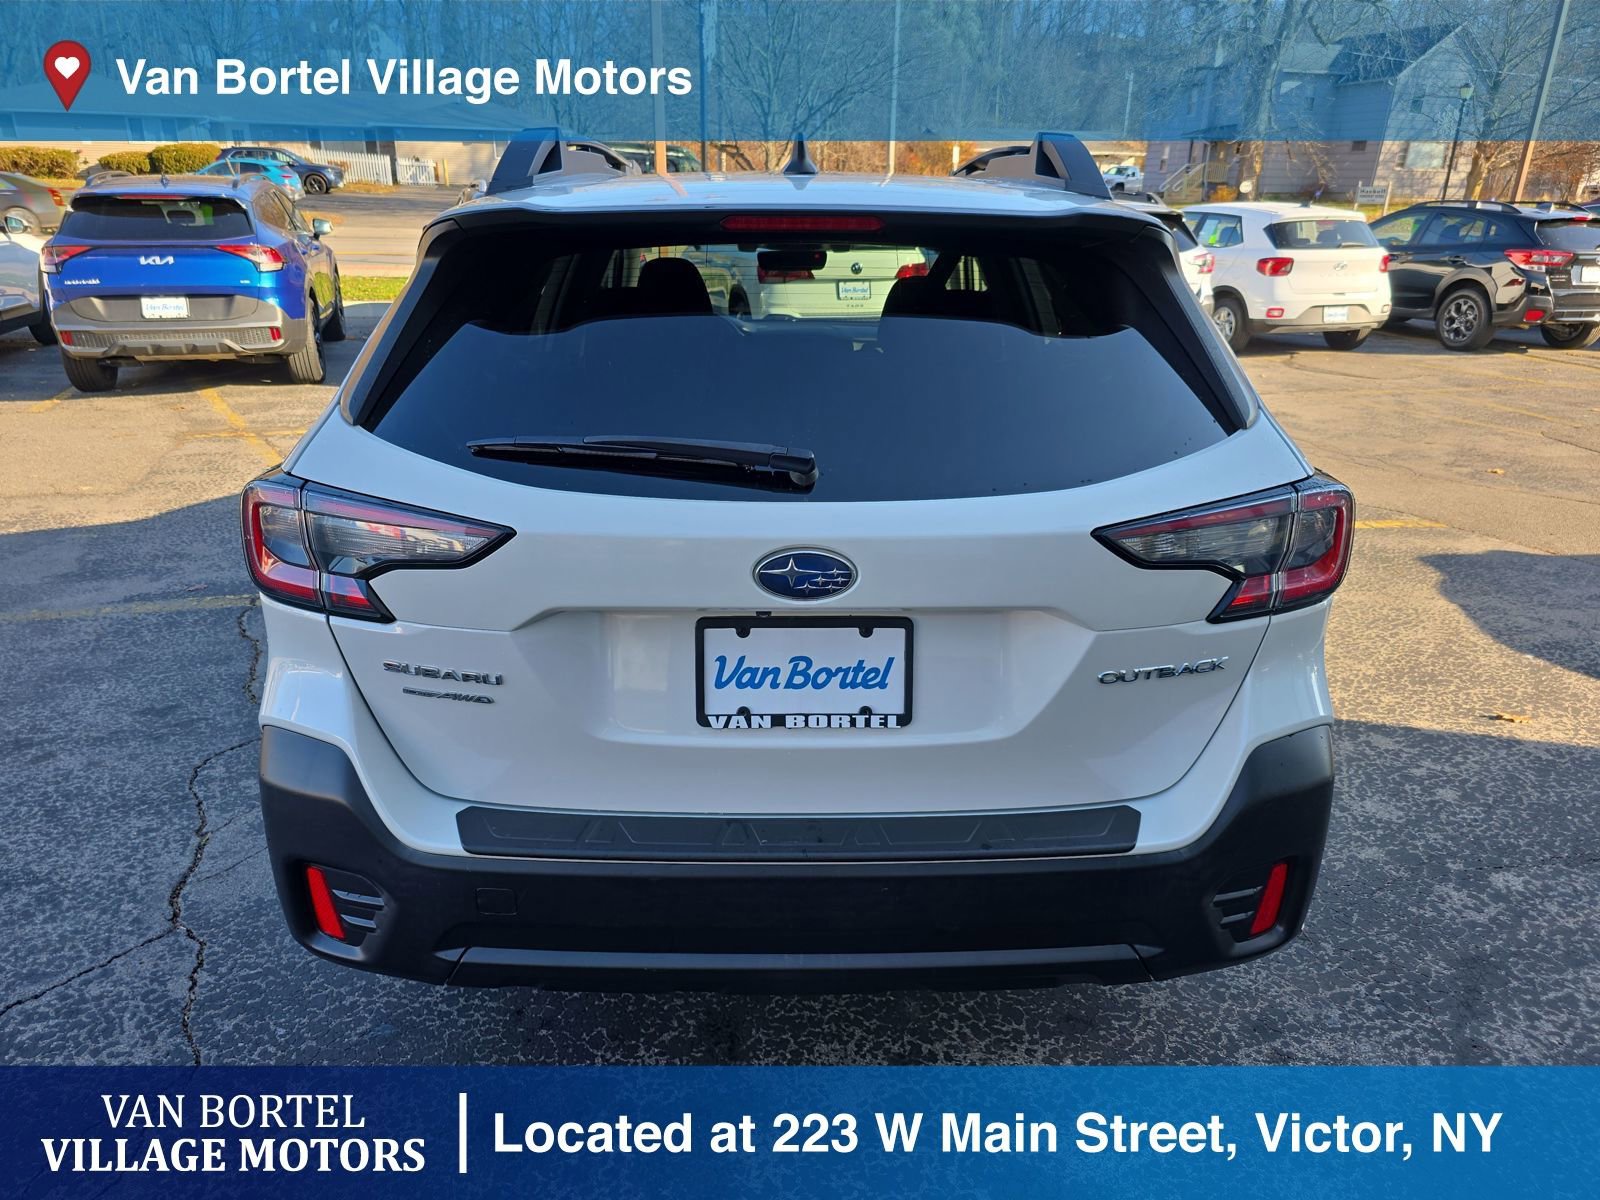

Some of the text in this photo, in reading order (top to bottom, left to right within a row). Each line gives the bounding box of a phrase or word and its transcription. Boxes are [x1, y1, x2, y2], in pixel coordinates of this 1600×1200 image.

[139, 255, 175, 265] KIA
[383, 658, 504, 686] SUBARU
[714, 655, 895, 690] Van Bortel
[1098, 656, 1229, 684] OUTBACK
[437, 690, 495, 704] AWD
[707, 715, 901, 729] VAN BORTEL
